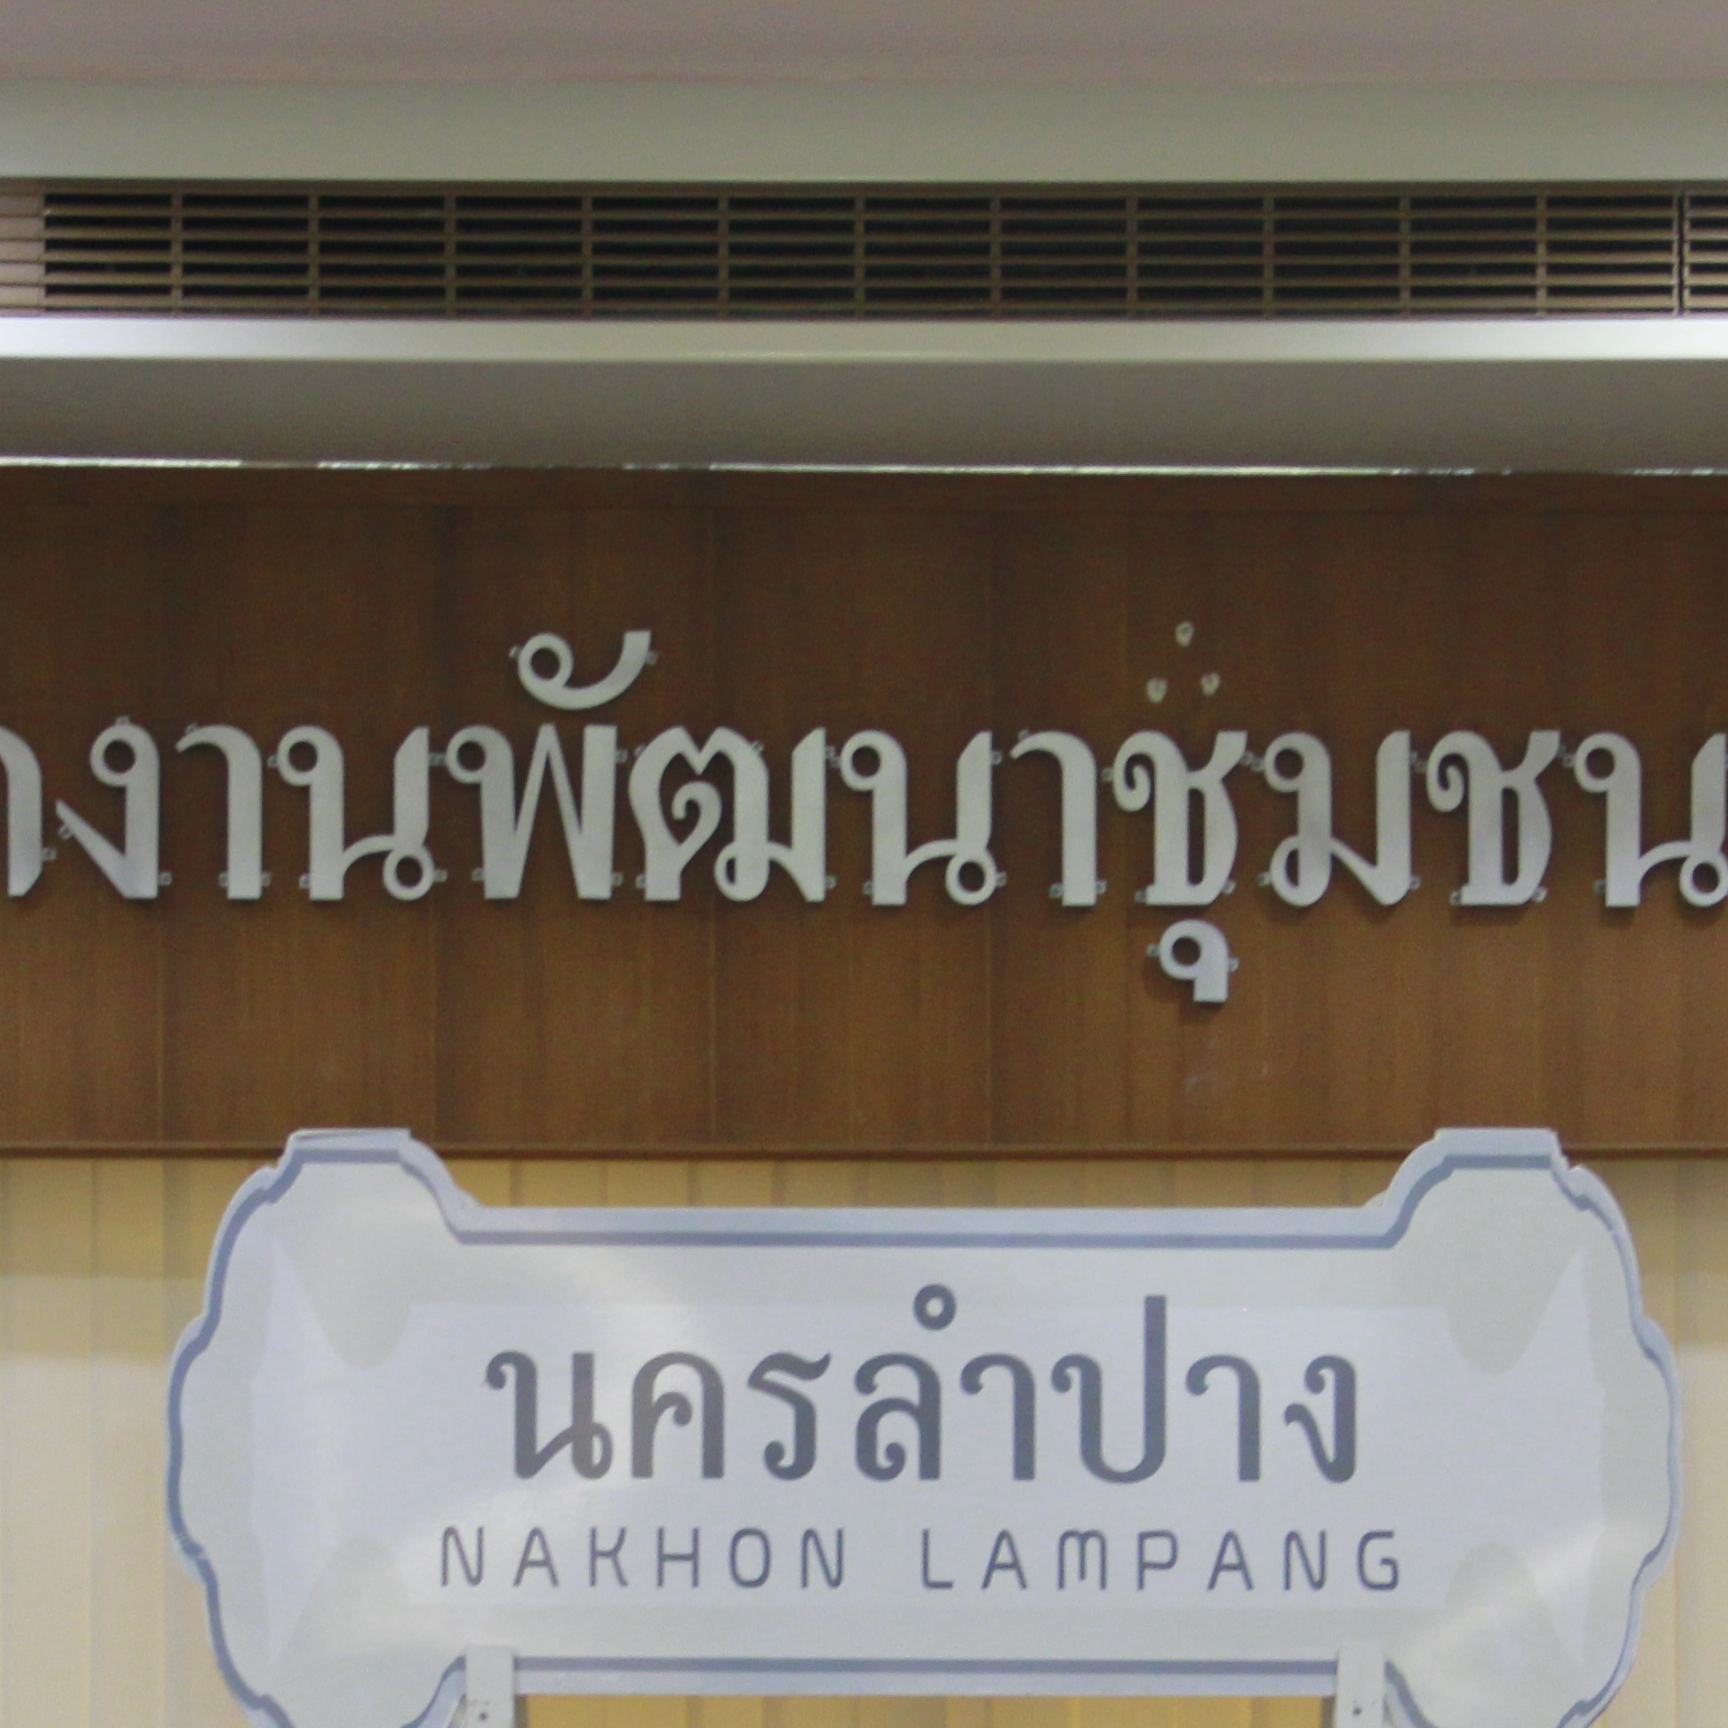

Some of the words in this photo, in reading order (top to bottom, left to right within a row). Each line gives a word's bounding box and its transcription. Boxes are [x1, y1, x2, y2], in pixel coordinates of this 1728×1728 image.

[484, 1283, 1357, 1484] นครลำปาง
[439, 1526, 846, 1589] NAKHON
[920, 1528, 1401, 1591] LAMPANG
